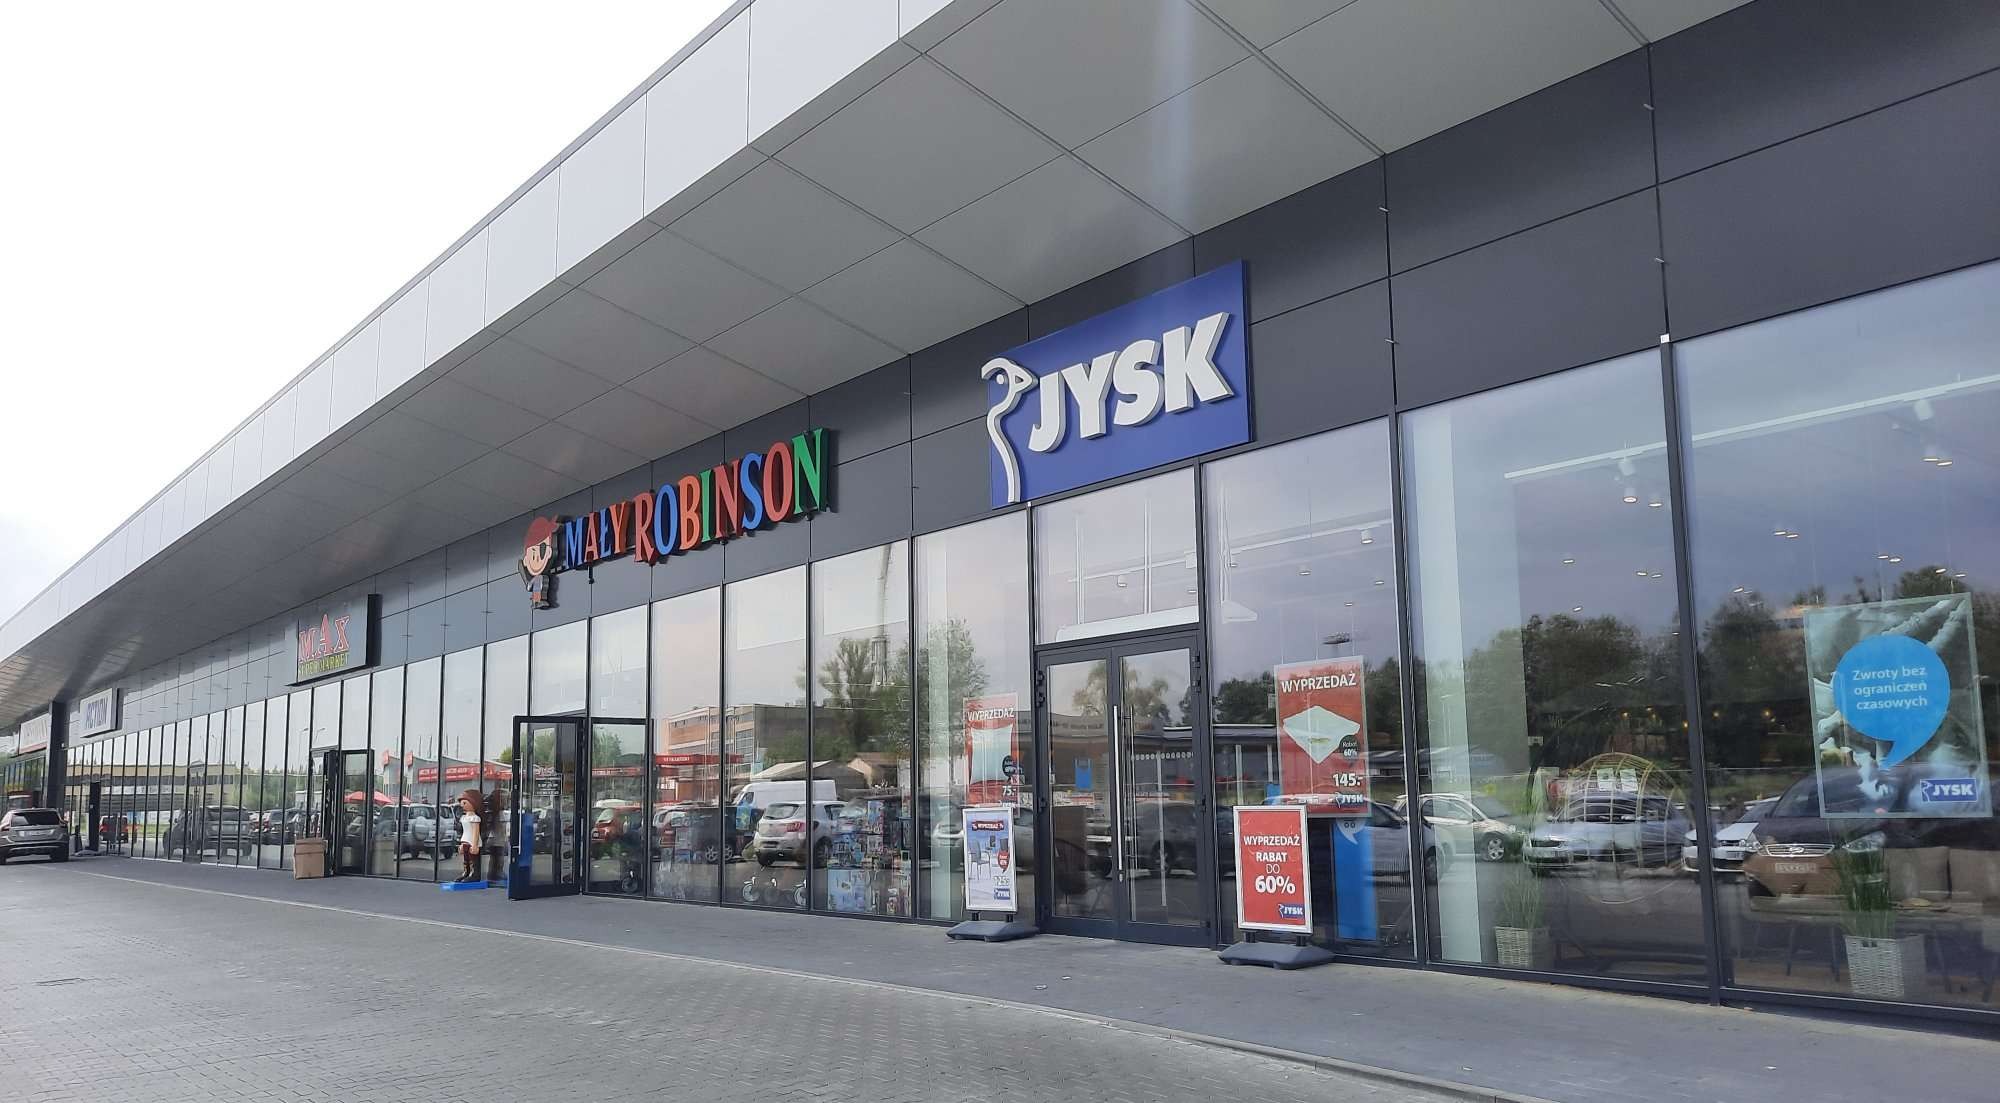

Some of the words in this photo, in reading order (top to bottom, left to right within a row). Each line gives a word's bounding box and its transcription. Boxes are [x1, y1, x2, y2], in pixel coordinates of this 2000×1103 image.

[1027, 311, 1235, 453] JYSK
[565, 501, 628, 570] MAŁY
[634, 427, 829, 563] ROBINSON
[299, 613, 350, 663] MAX
[1853, 669, 1898, 681] Zwroty
[1902, 666, 1927, 677] bez
[1281, 670, 1357, 693] WYPRZEDAŻ
[1854, 681, 1928, 697] ograniczeń
[1856, 696, 1928, 710] czasowych
[1932, 783, 1974, 797] JYSK
[1341, 794, 1363, 804] JYSK
[1243, 834, 1300, 846] WYPRZEDAŻ
[1255, 851, 1287, 863] RABAT
[1265, 863, 1280, 874] DO
[1255, 875, 1296, 894] 60%
[1283, 906, 1303, 915] JYSK
